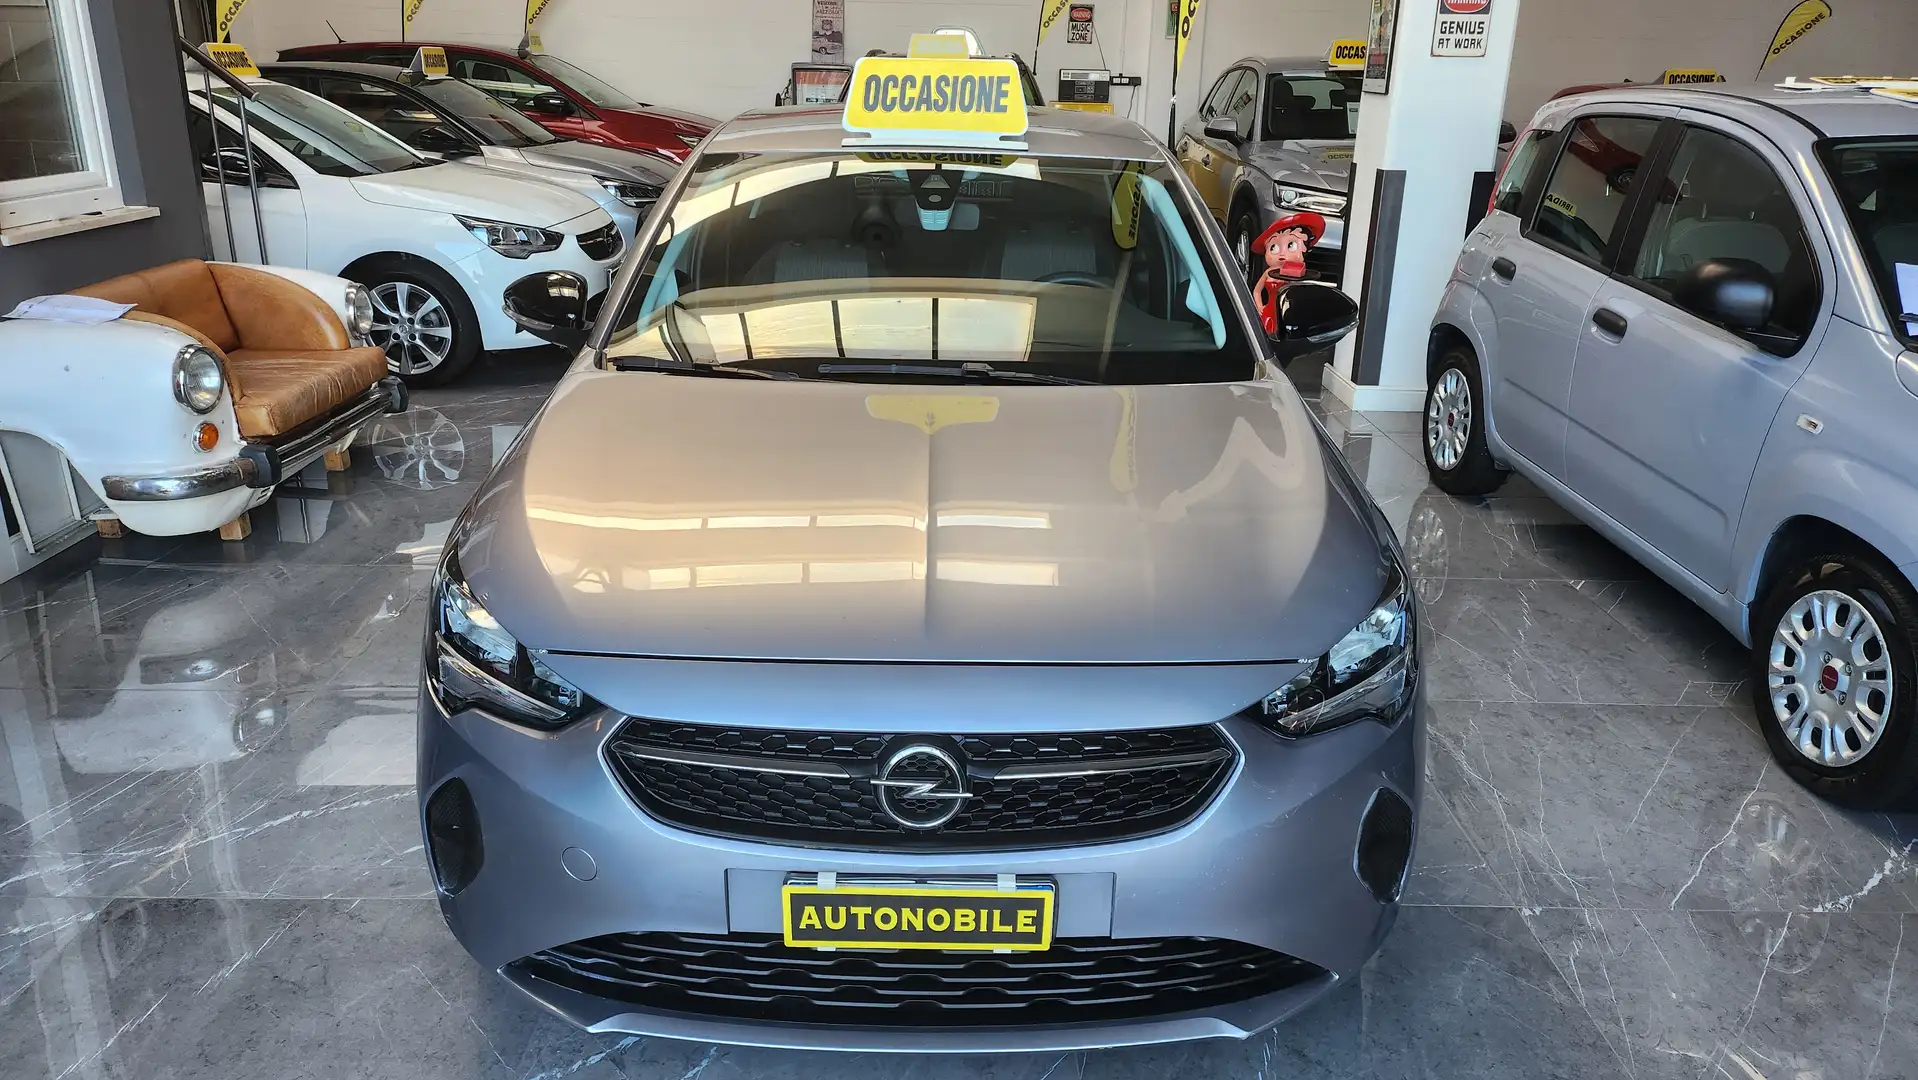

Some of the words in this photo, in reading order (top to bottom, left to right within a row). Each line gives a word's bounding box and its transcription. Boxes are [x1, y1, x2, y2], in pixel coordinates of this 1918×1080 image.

[219, 0, 246, 32] OCCA
[1070, 22, 1091, 33] MUSIC
[1440, 20, 1485, 35] GENIUS
[1772, 12, 1826, 55] OCCASIONE
[1071, 32, 1088, 42] ZONE
[1437, 37, 1451, 49] AT
[1454, 37, 1483, 49] WORK
[1668, 73, 1716, 85] OCCASIONE
[863, 74, 1011, 113] OCCASIONE
[798, 905, 1038, 934] AUTONOBILE
